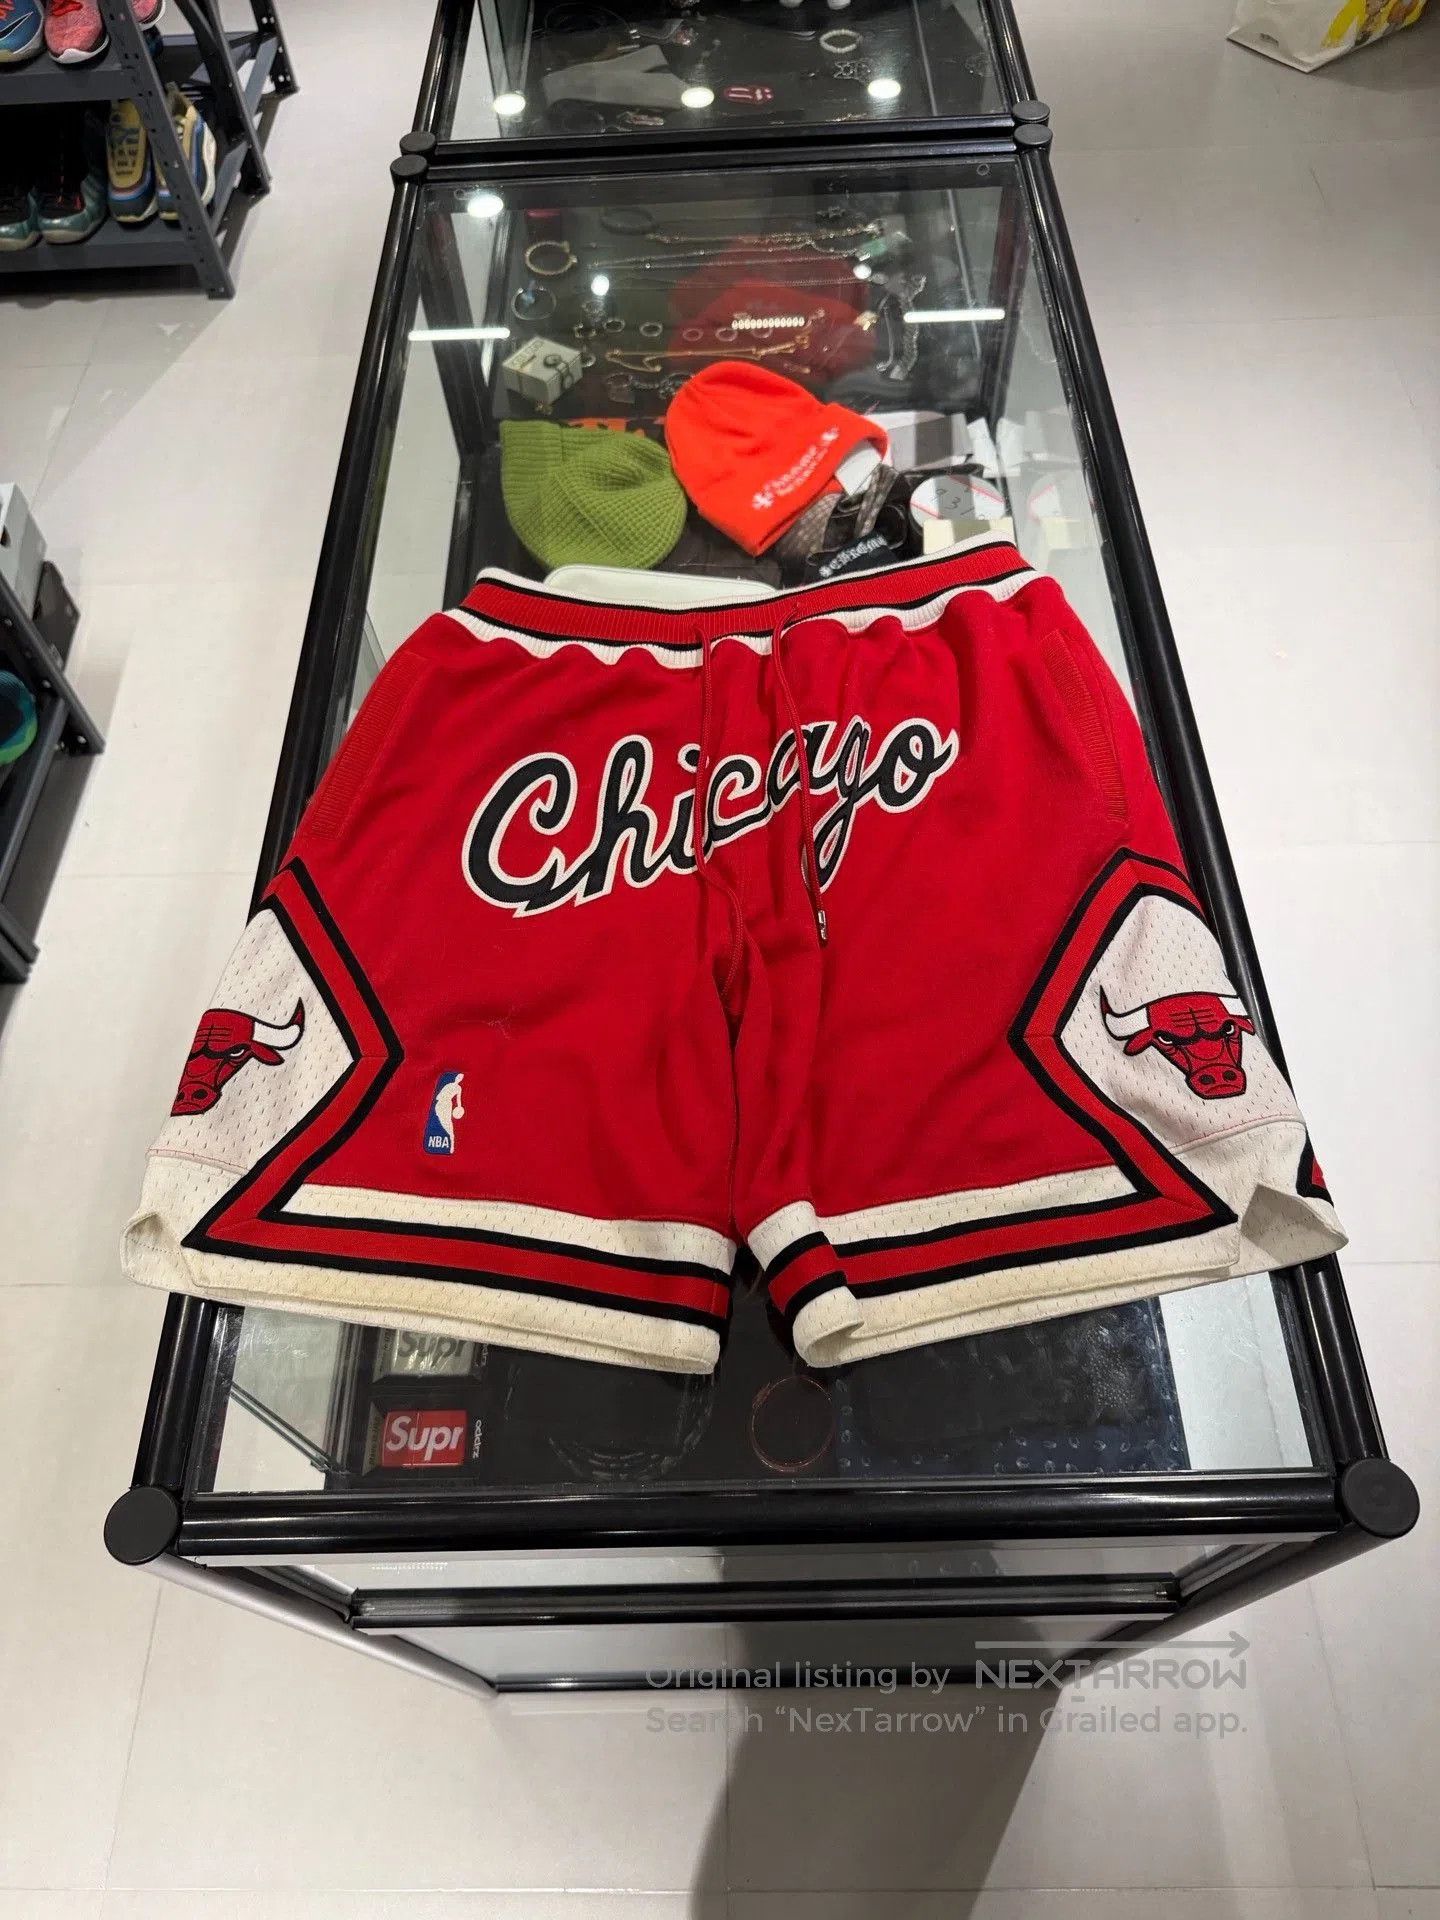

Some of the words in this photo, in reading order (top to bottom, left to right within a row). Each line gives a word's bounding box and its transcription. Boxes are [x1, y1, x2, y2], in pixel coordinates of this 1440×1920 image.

[461, 715, 959, 918] Chicago
[428, 1135, 450, 1148] NBA
[386, 1416, 464, 1462] Supr
